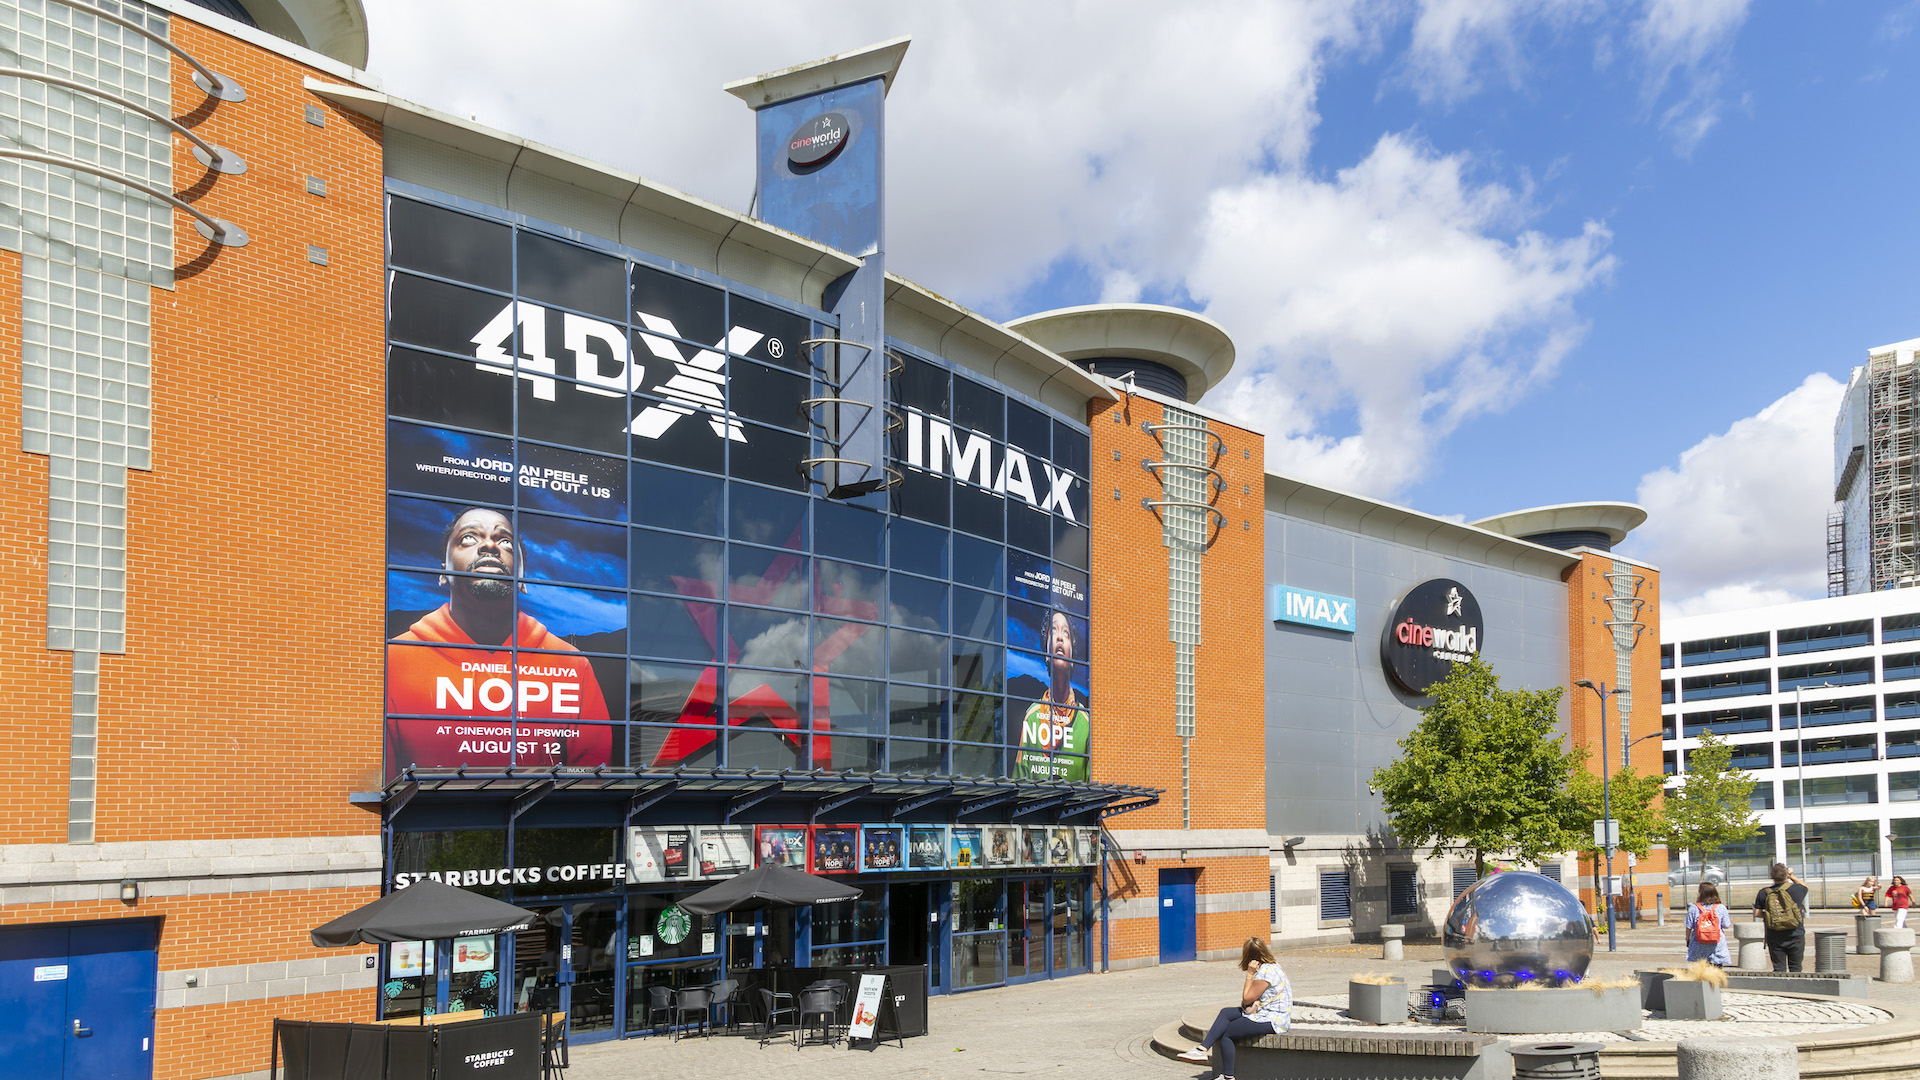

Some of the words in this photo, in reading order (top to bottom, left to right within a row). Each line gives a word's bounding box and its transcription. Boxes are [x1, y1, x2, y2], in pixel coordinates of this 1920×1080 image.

[791, 127, 841, 150] cineworld
[443, 456, 469, 467] FROM
[544, 468, 588, 485] PEELE
[908, 405, 1078, 527] IMAX
[416, 463, 497, 482] WRITER/DIRECTOR
[498, 475, 511, 483] OF
[519, 476, 548, 490] GET
[550, 480, 580, 494] OUT
[582, 488, 589, 496] &
[591, 486, 611, 499] US
[1052, 585, 1062, 594] GET
[1062, 588, 1073, 598] OUT
[1076, 592, 1084, 601] US
[1286, 592, 1349, 626] IMAX
[1396, 617, 1477, 654] cineworld
[461, 662, 511, 674] DANIEL
[519, 665, 578, 678] KALUUYA
[436, 676, 580, 714] NOPE
[436, 726, 452, 735] AT
[534, 728, 580, 738] IPSWICH
[1022, 720, 1074, 749] NOPE
[458, 740, 538, 754] AUGUST
[542, 742, 561, 754] 12
[1031, 765, 1060, 776] AUGUST
[1061, 767, 1068, 776] 12
[395, 866, 542, 890] STARBUCKS
[546, 863, 626, 882] COFFEE
[464, 1049, 514, 1063] STARBUCKS
[473, 1058, 505, 1068] COFFEE
